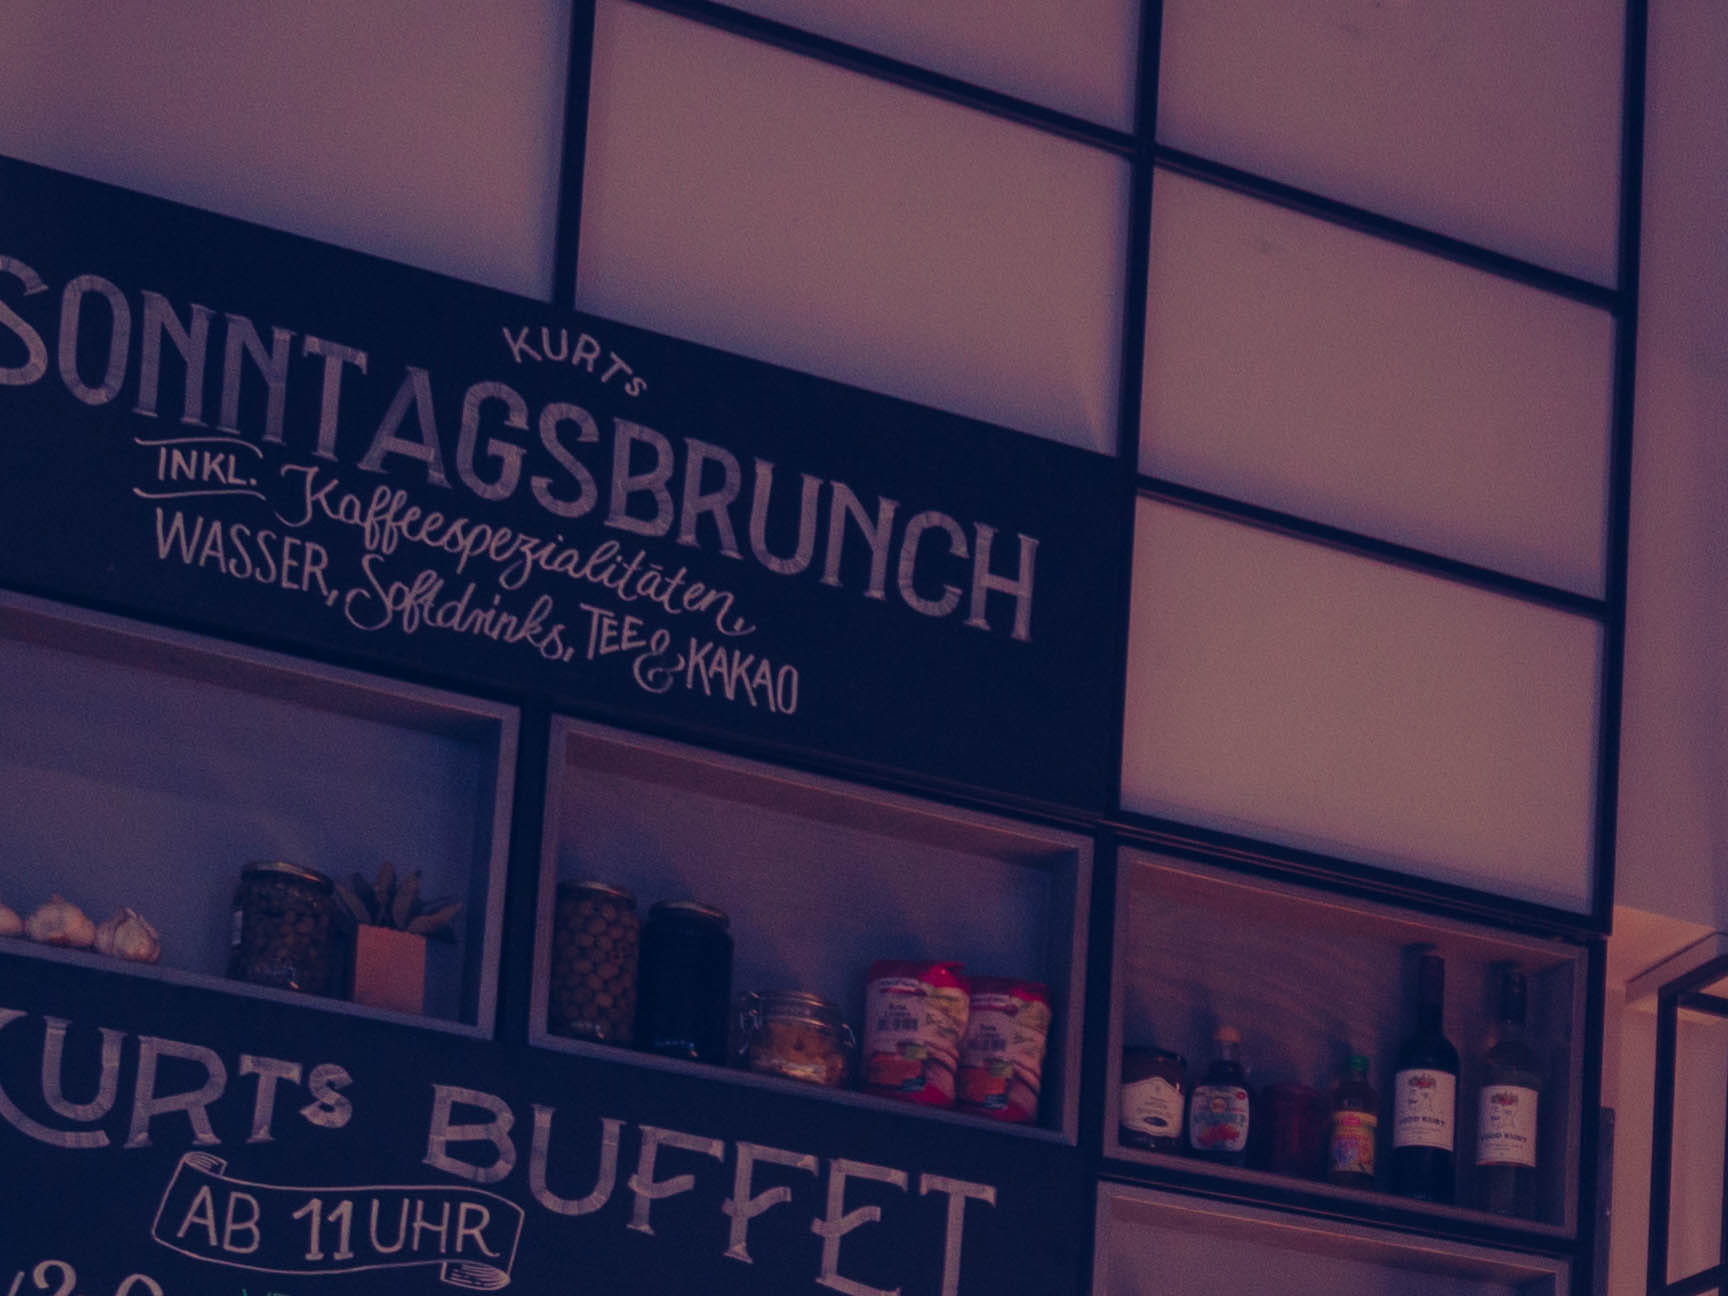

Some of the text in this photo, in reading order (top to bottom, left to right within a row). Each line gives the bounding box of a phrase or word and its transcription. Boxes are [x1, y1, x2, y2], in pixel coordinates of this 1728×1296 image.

[0, 256, 1039, 642] SONNTAGSBRUNCH
[157, 446, 259, 489] INKL.
[155, 508, 798, 715] WASSER, Softdrinks, TEE & KAKAO
[176, 1193, 501, 1262] AB 11 UHR
